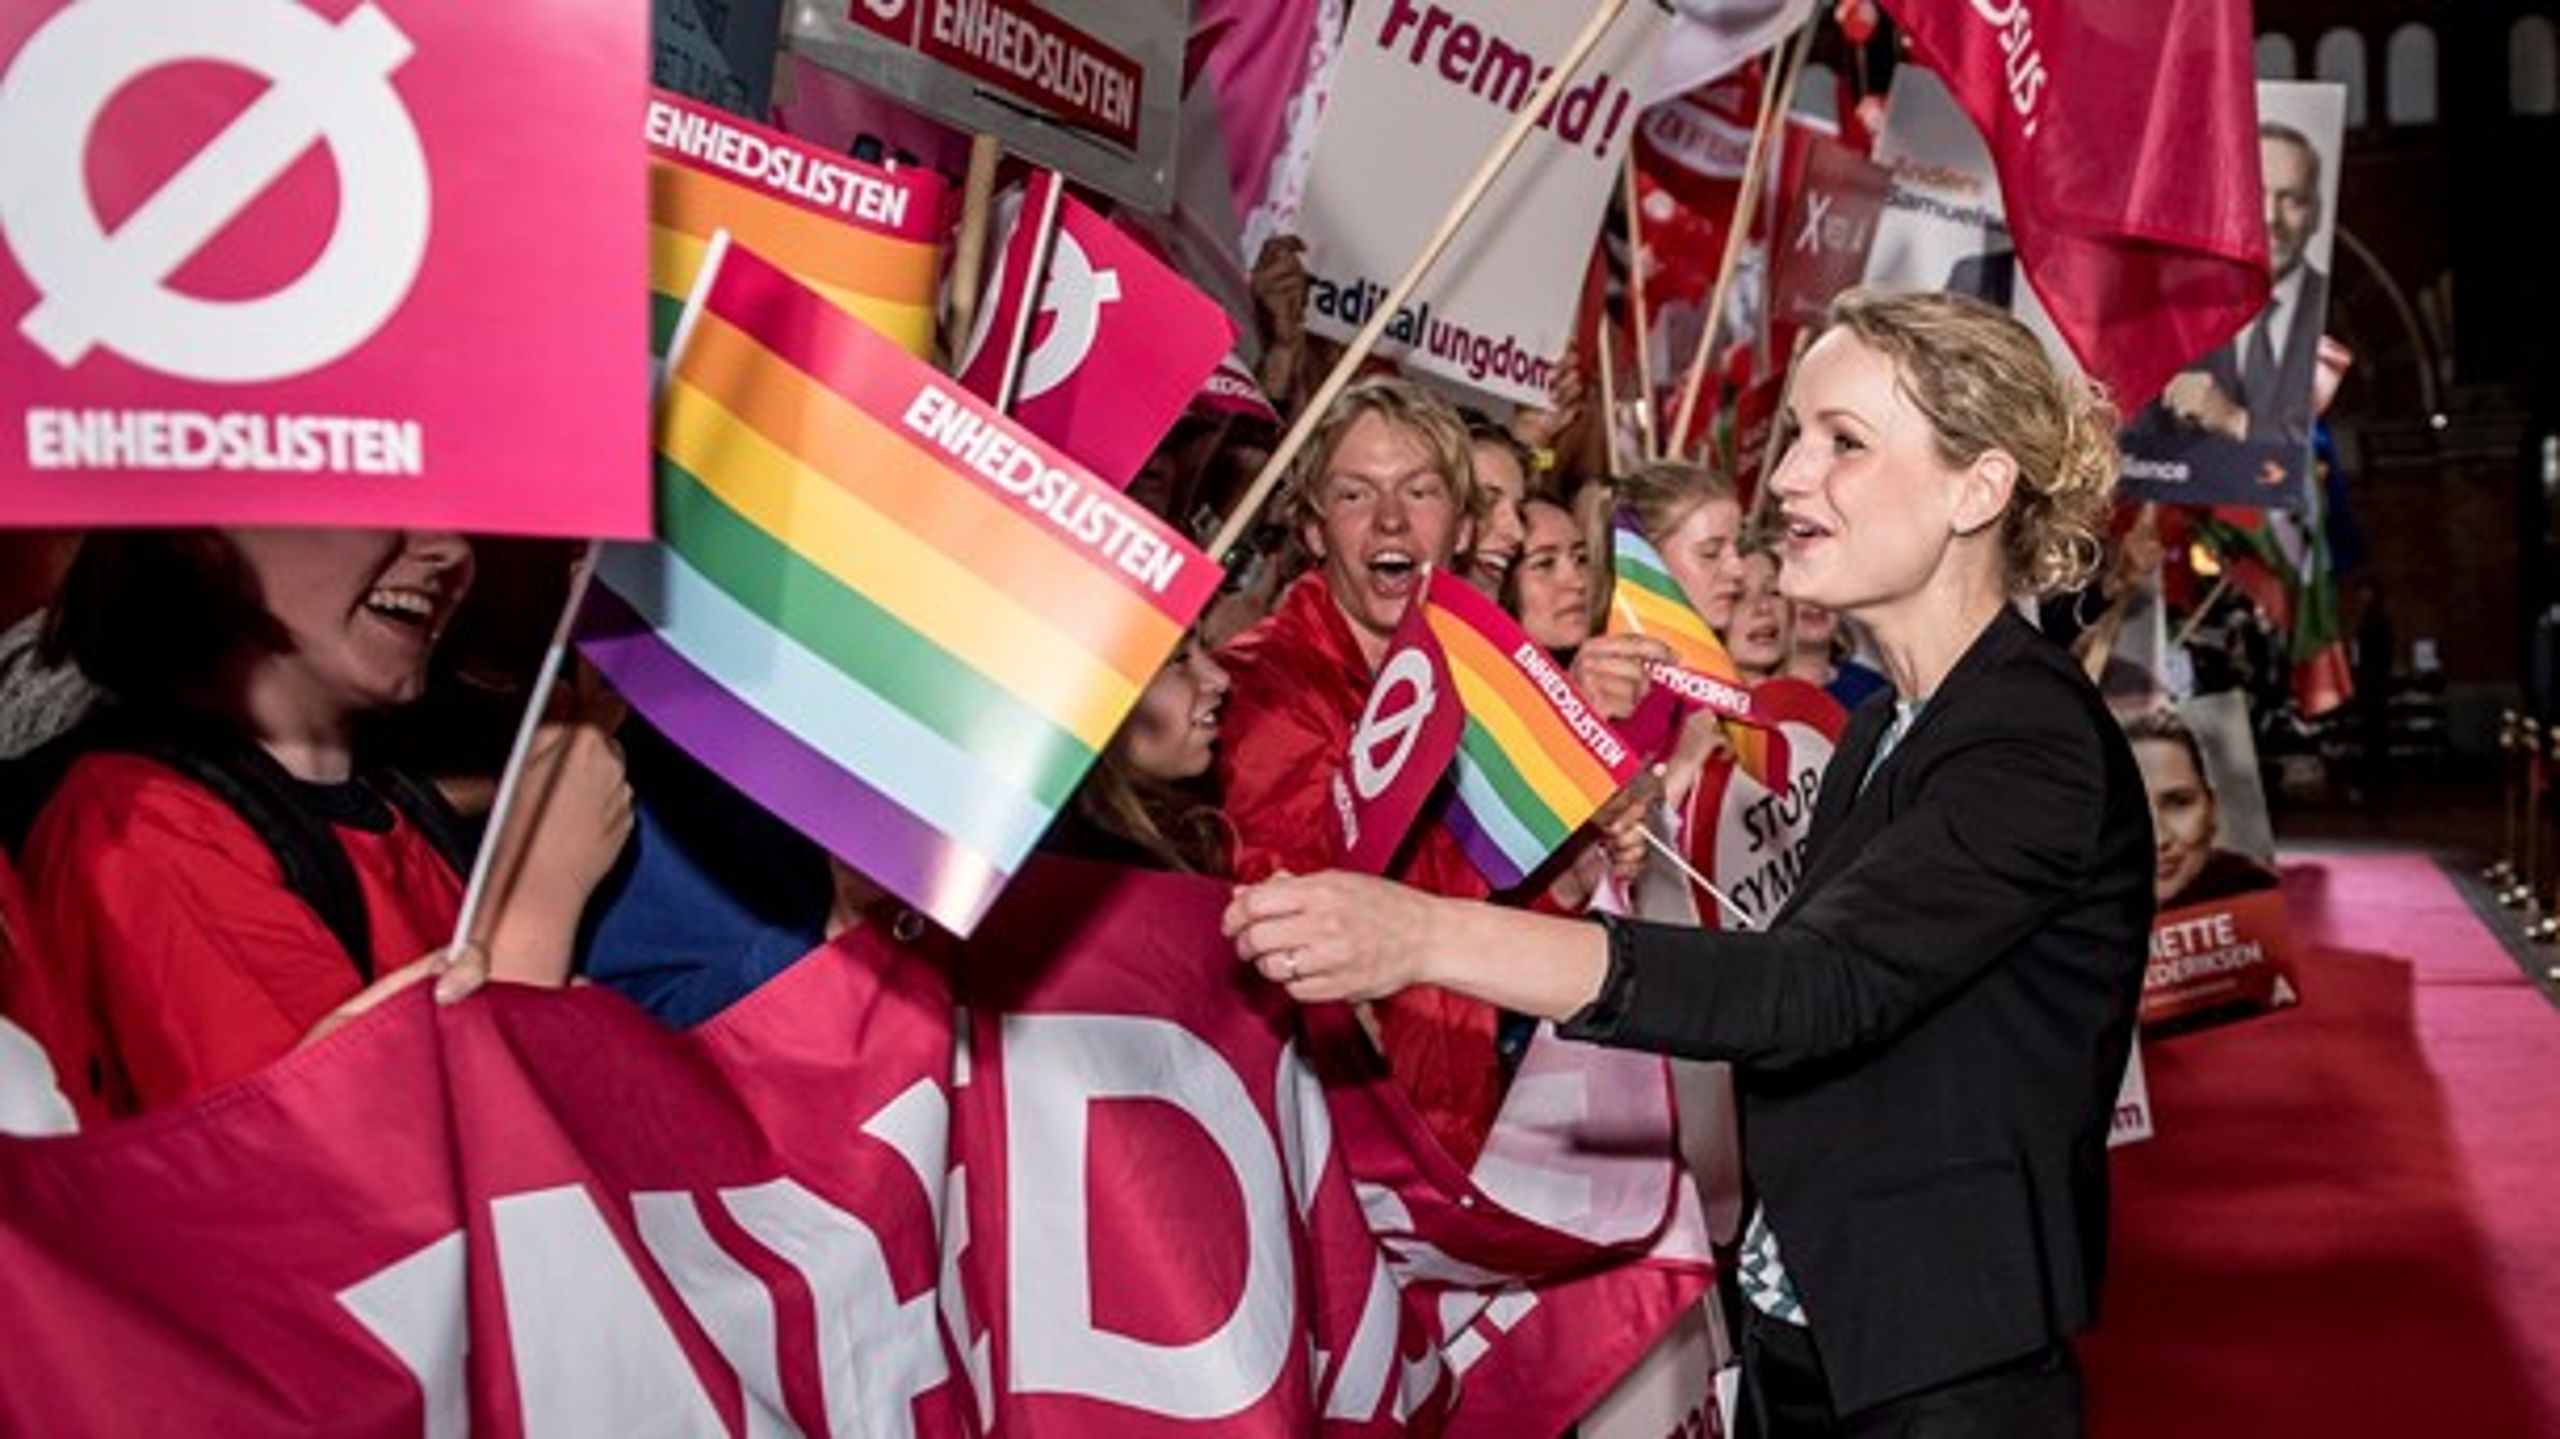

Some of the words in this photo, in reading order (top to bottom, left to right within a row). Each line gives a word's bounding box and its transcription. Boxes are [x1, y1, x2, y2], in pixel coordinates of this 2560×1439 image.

[932, 0, 1135, 131] ENHEDSLISTEN
[644, 100, 909, 228] ENHEDSLISTEN
[26, 407, 424, 477] ENHEDSLISTEN
[902, 384, 1186, 593] ENHEDSLISTEN
[1513, 642, 1626, 768] ENHEDSLISTEN
[1744, 767, 1818, 853] STOP
